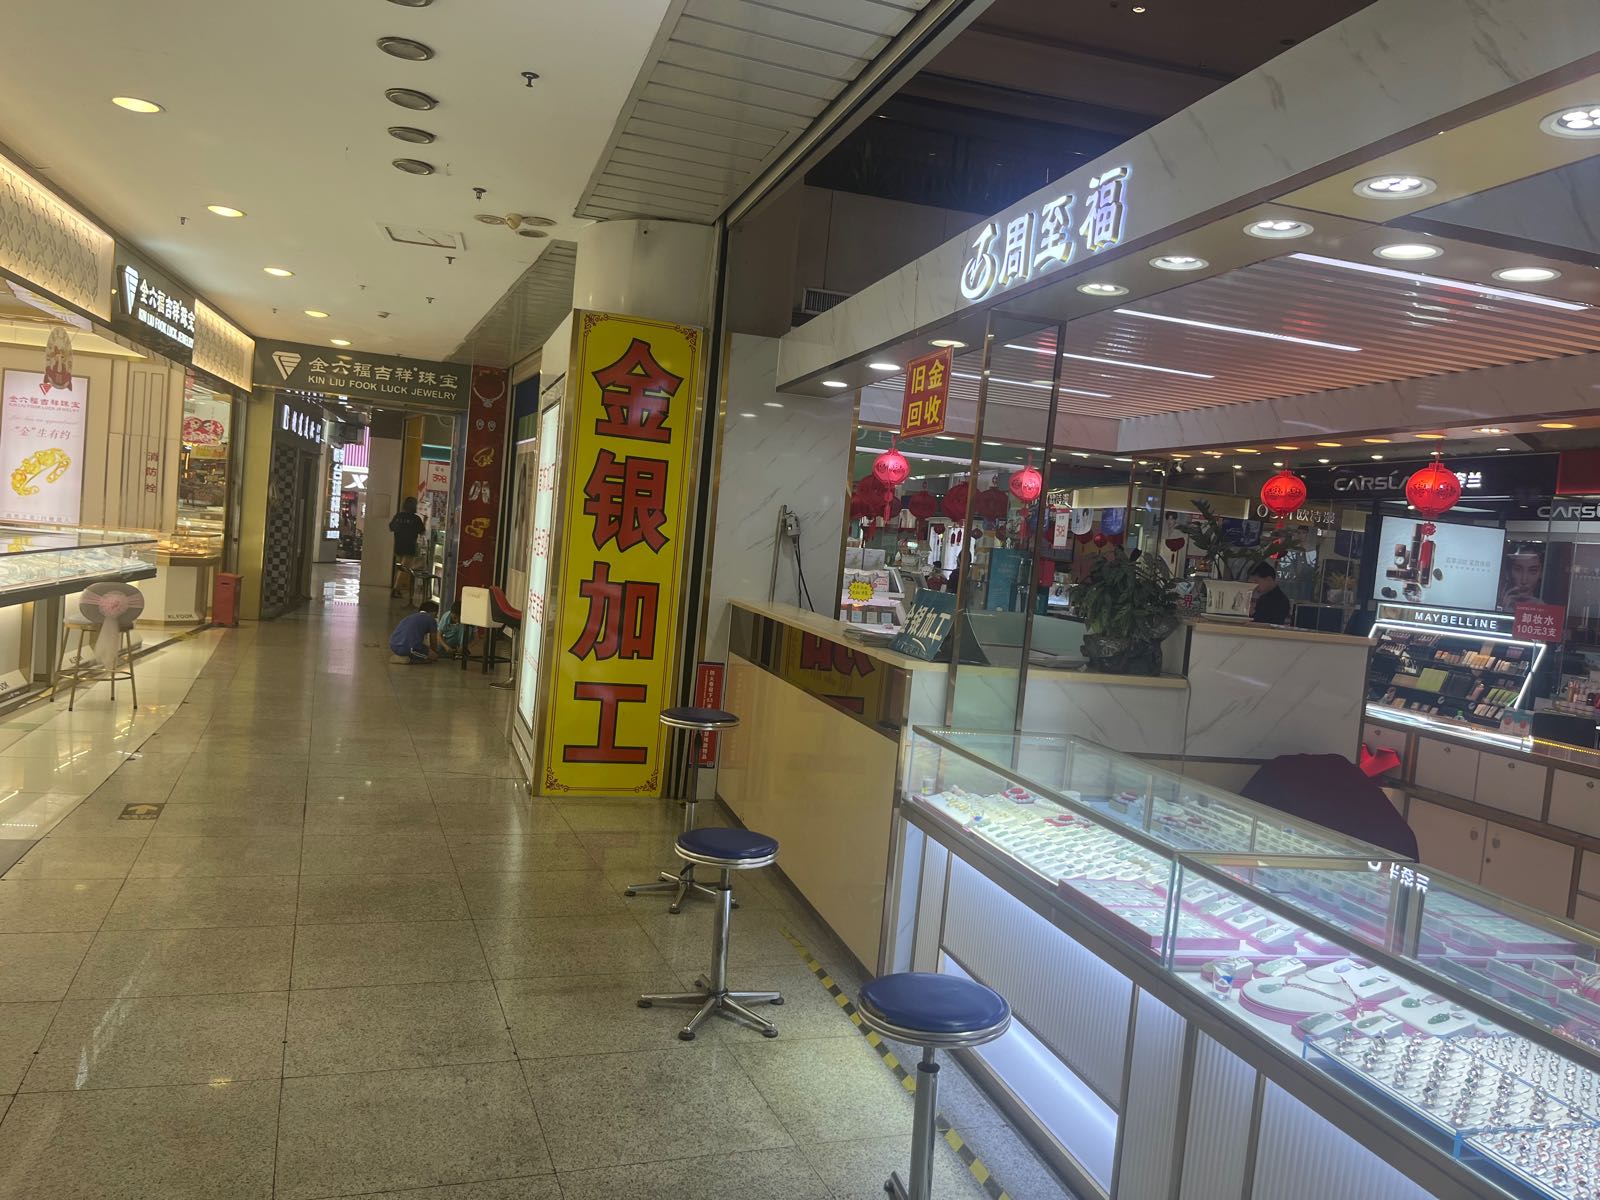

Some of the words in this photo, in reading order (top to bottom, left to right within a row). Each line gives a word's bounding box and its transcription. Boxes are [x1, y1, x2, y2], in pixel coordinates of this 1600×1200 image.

[998, 167, 1128, 286] 周至福
[308, 357, 458, 389] 金六福吉祥珠宝
[308, 375, 326, 385] KIN
[329, 377, 345, 387] LIU
[349, 380, 378, 391] FOOK
[381, 384, 408, 395] LUCK
[411, 388, 457, 401] JEWELRY
[563, 337, 684, 764] 金银加工
[1414, 611, 1498, 630] MAYBELLINE
[1516, 624, 1557, 638] 100元3支
[1521, 612, 1555, 626] 卸妆水
